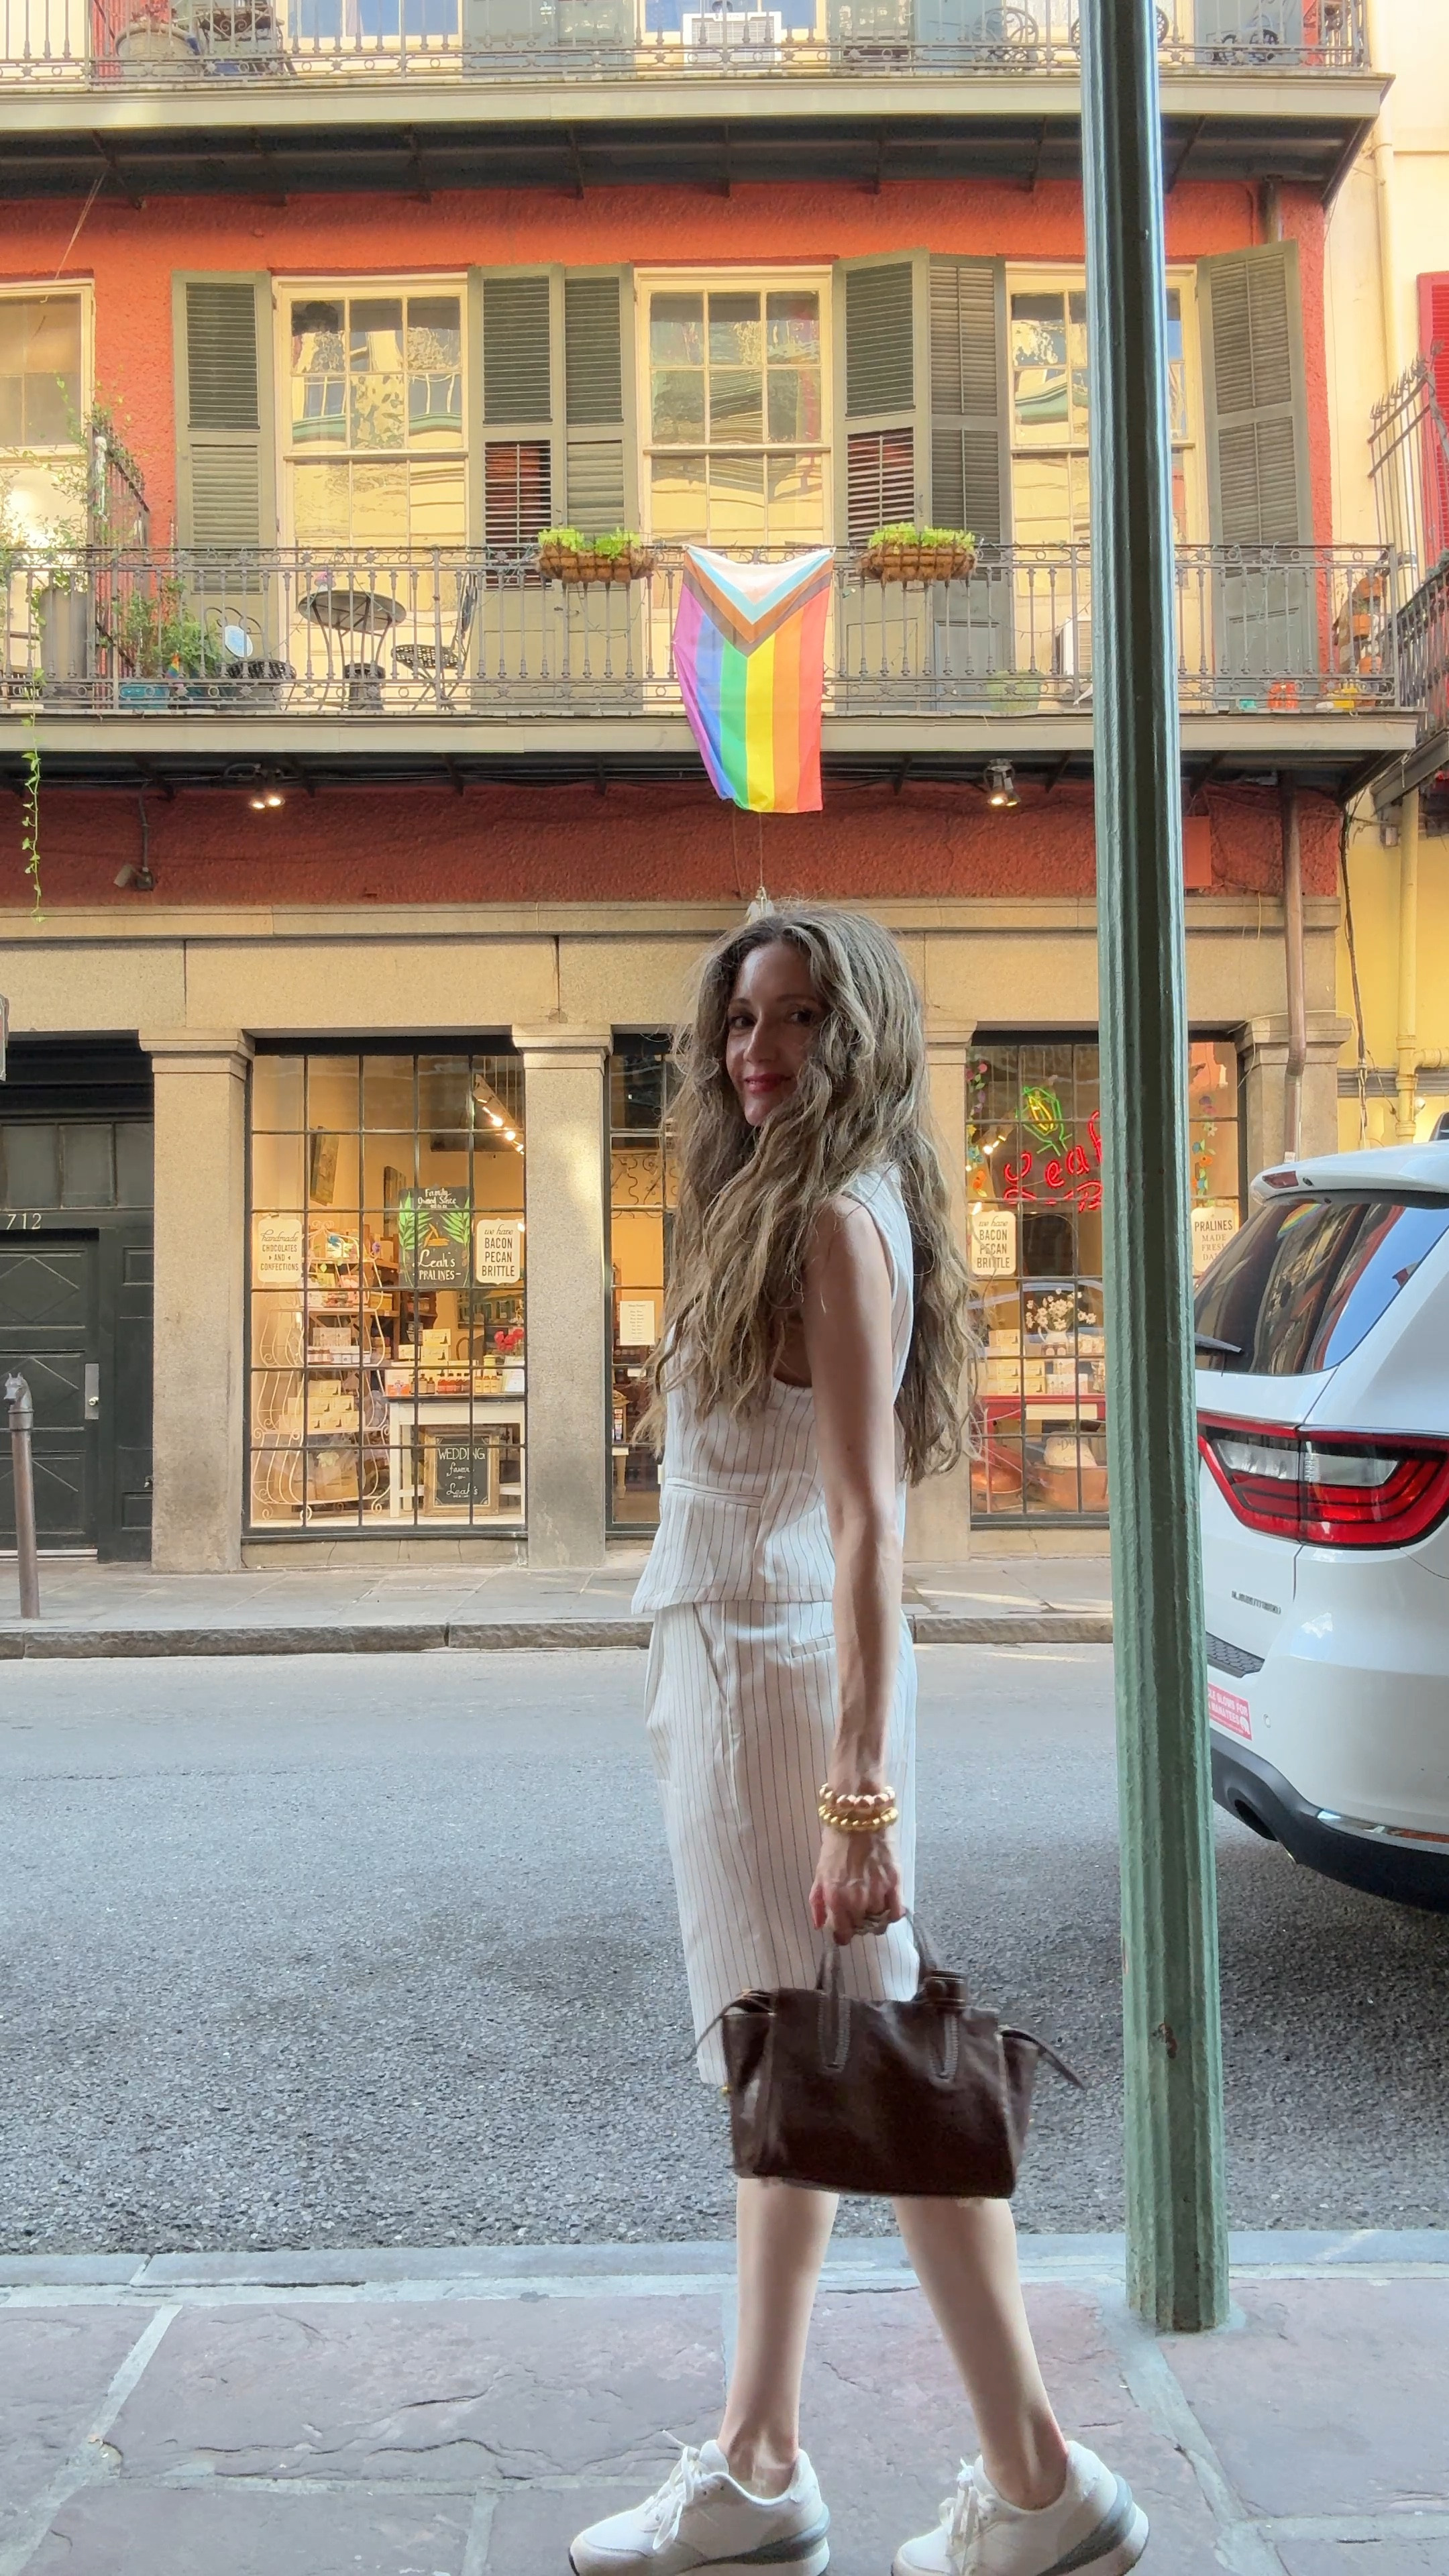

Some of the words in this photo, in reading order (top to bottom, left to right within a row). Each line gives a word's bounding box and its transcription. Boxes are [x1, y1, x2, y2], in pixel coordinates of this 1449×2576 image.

[7, 1213, 42, 1229] 712
[1195, 1220, 1233, 1232] PRALINES
[496, 1224, 514, 1235] have
[979, 1229, 1008, 1240] BACON
[260, 1229, 299, 1242] handmade
[262, 1244, 297, 1252] CHOCOLATES
[484, 1238, 513, 1248] BACON
[485, 1252, 512, 1263] PECAN
[1203, 1253, 1217, 1261] DA
[260, 1263, 299, 1271] CONFECTIONS
[482, 1265, 515, 1277] BRITTLE
[419, 1269, 455, 1281] PRALINES
[437, 1448, 486, 1460] WEDDING
